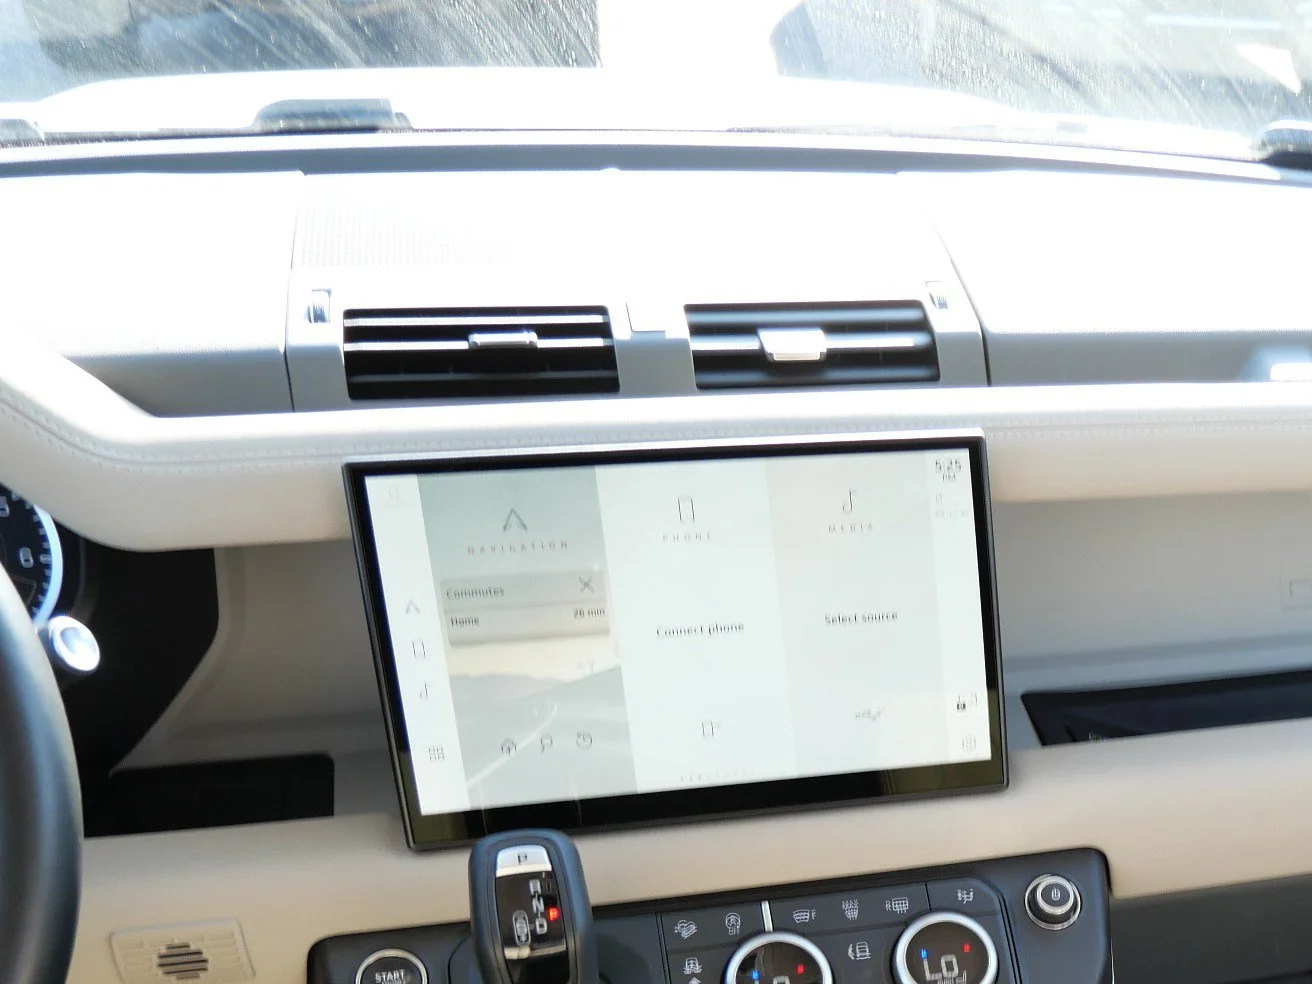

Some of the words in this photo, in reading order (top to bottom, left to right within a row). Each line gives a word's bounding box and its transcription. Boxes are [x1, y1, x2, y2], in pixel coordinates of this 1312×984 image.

[466, 539, 568, 556] NAVIGATION
[446, 585, 505, 601] Commutes
[450, 615, 480, 628] Home
[824, 613, 858, 627] Select
[861, 610, 898, 624] source
[655, 622, 704, 638] Connect
[707, 620, 745, 636] phone
[532, 897, 545, 914] N
[535, 917, 548, 935] D
[922, 953, 959, 982] LO
[375, 969, 405, 984] START
